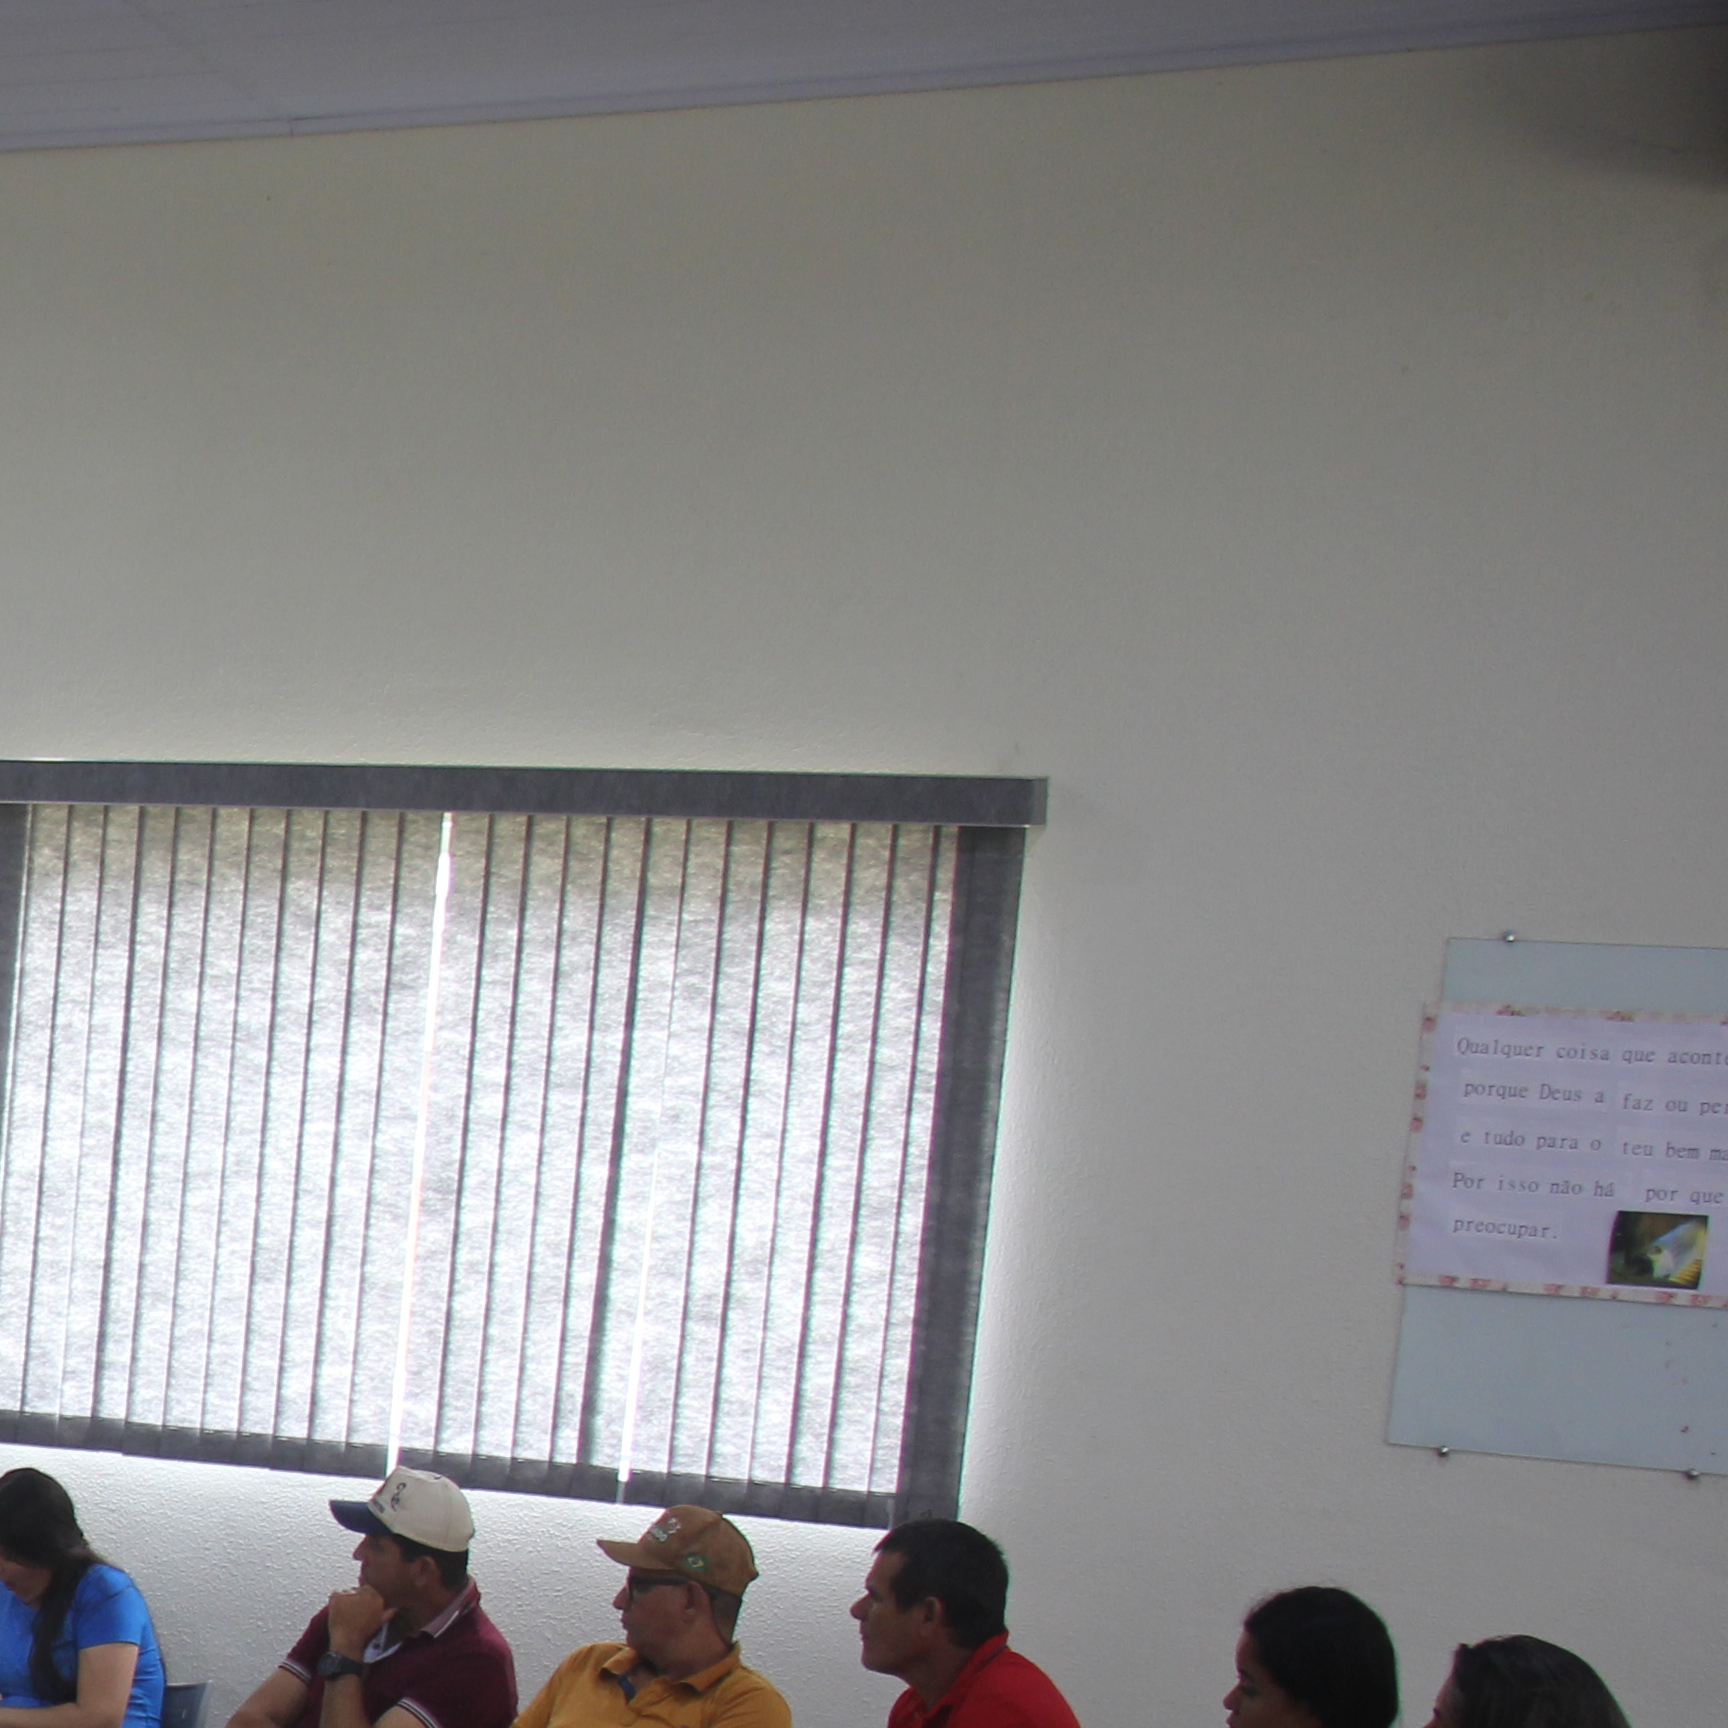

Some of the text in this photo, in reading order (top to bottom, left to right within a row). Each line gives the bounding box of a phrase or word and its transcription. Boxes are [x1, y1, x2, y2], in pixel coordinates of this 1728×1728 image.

[1456, 1037, 1545, 1058] Qualquer
[1556, 1043, 1610, 1060] coisa
[1622, 1050, 1656, 1064] que
[1463, 1082, 1529, 1099] porque
[1539, 1083, 1583, 1101] Deus
[1594, 1091, 1605, 1103] a
[1623, 1093, 1653, 1111] faz
[1665, 1100, 1688, 1112] ou
[1460, 1132, 1471, 1143] e
[1484, 1130, 1526, 1146] tudo
[1536, 1136, 1578, 1150] para
[1590, 1138, 1602, 1151] o
[1623, 1142, 1653, 1156] teu
[1666, 1142, 1699, 1159] bem
[1452, 1172, 1724, 1205] Por isso não há por que
[1452, 1218, 1558, 1239] preocupar.
